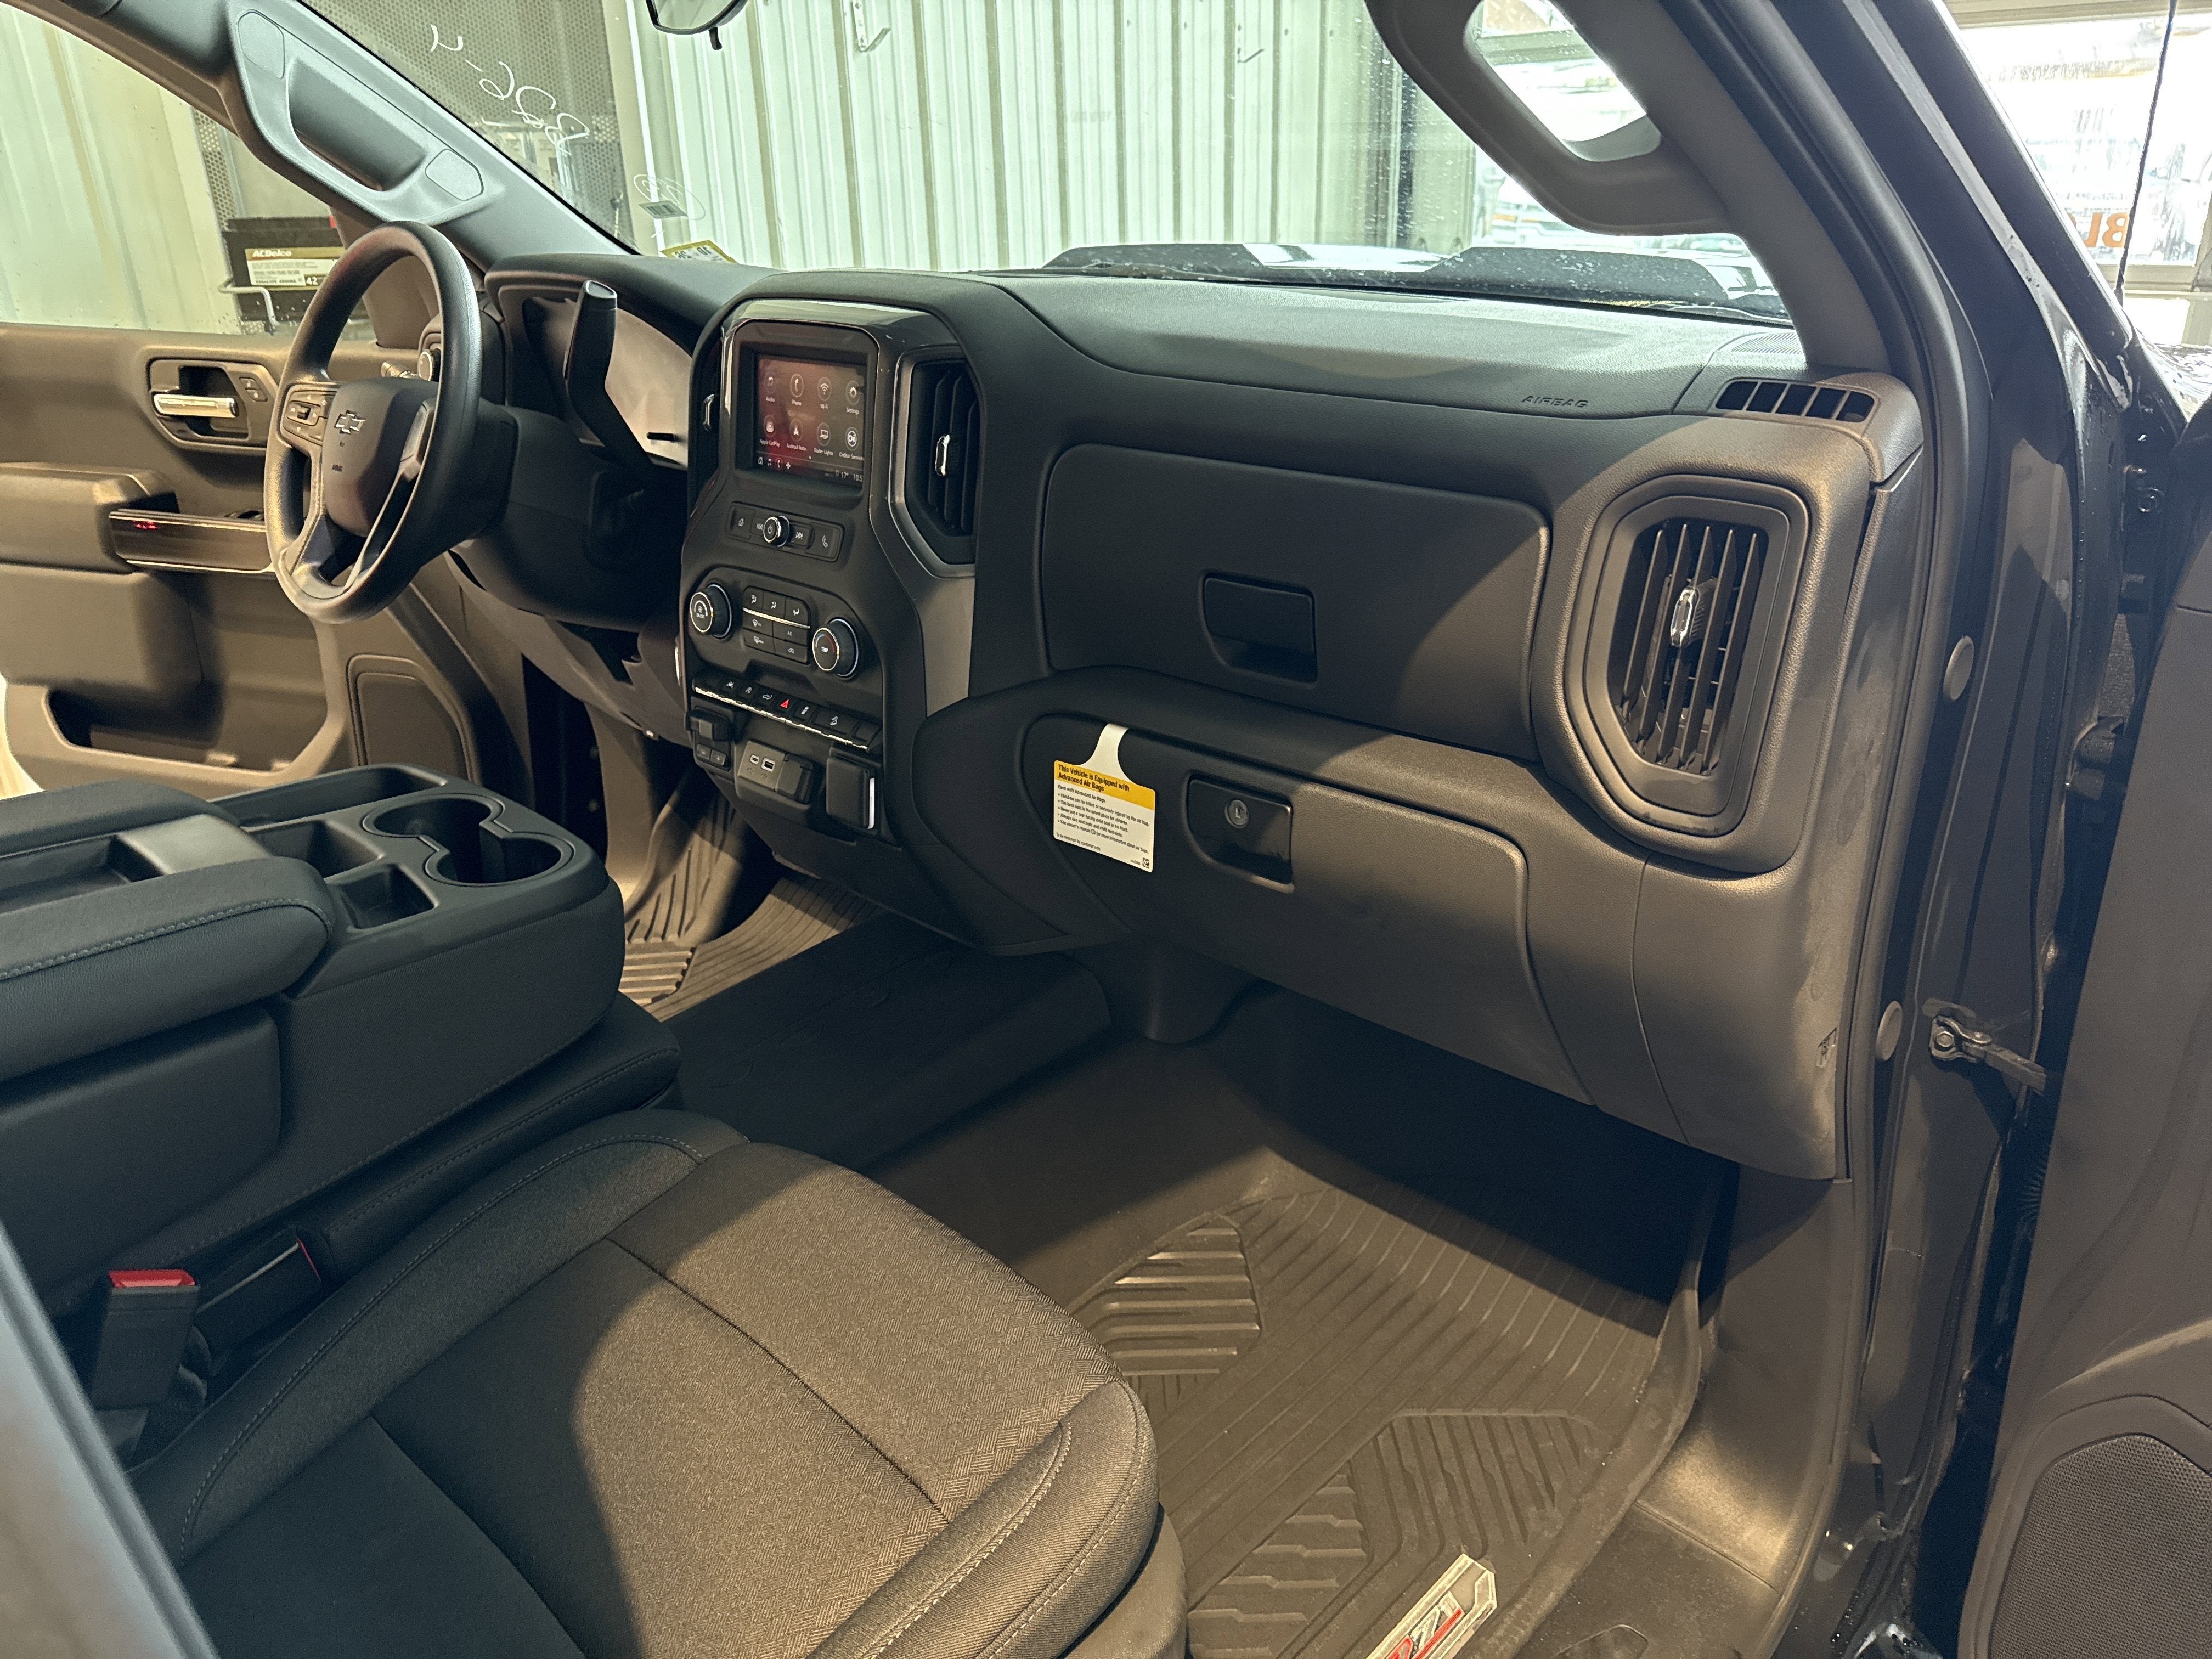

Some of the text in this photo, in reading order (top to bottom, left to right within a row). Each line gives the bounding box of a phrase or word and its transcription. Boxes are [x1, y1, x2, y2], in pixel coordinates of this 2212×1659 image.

[306, 276, 318, 285] 42
[1521, 396, 1588, 408] AIRBAG
[846, 407, 860, 415] Settings
[853, 473, 863, 482] 10:5
[1058, 764, 1069, 772] This
[1070, 768, 1088, 778] Vehicle
[1094, 775, 1117, 787] Equipped
[1119, 783, 1130, 792] with
[1058, 772, 1082, 785] Advanced
[1092, 783, 1104, 792] Bags
[1075, 789, 1091, 798] Advanced
